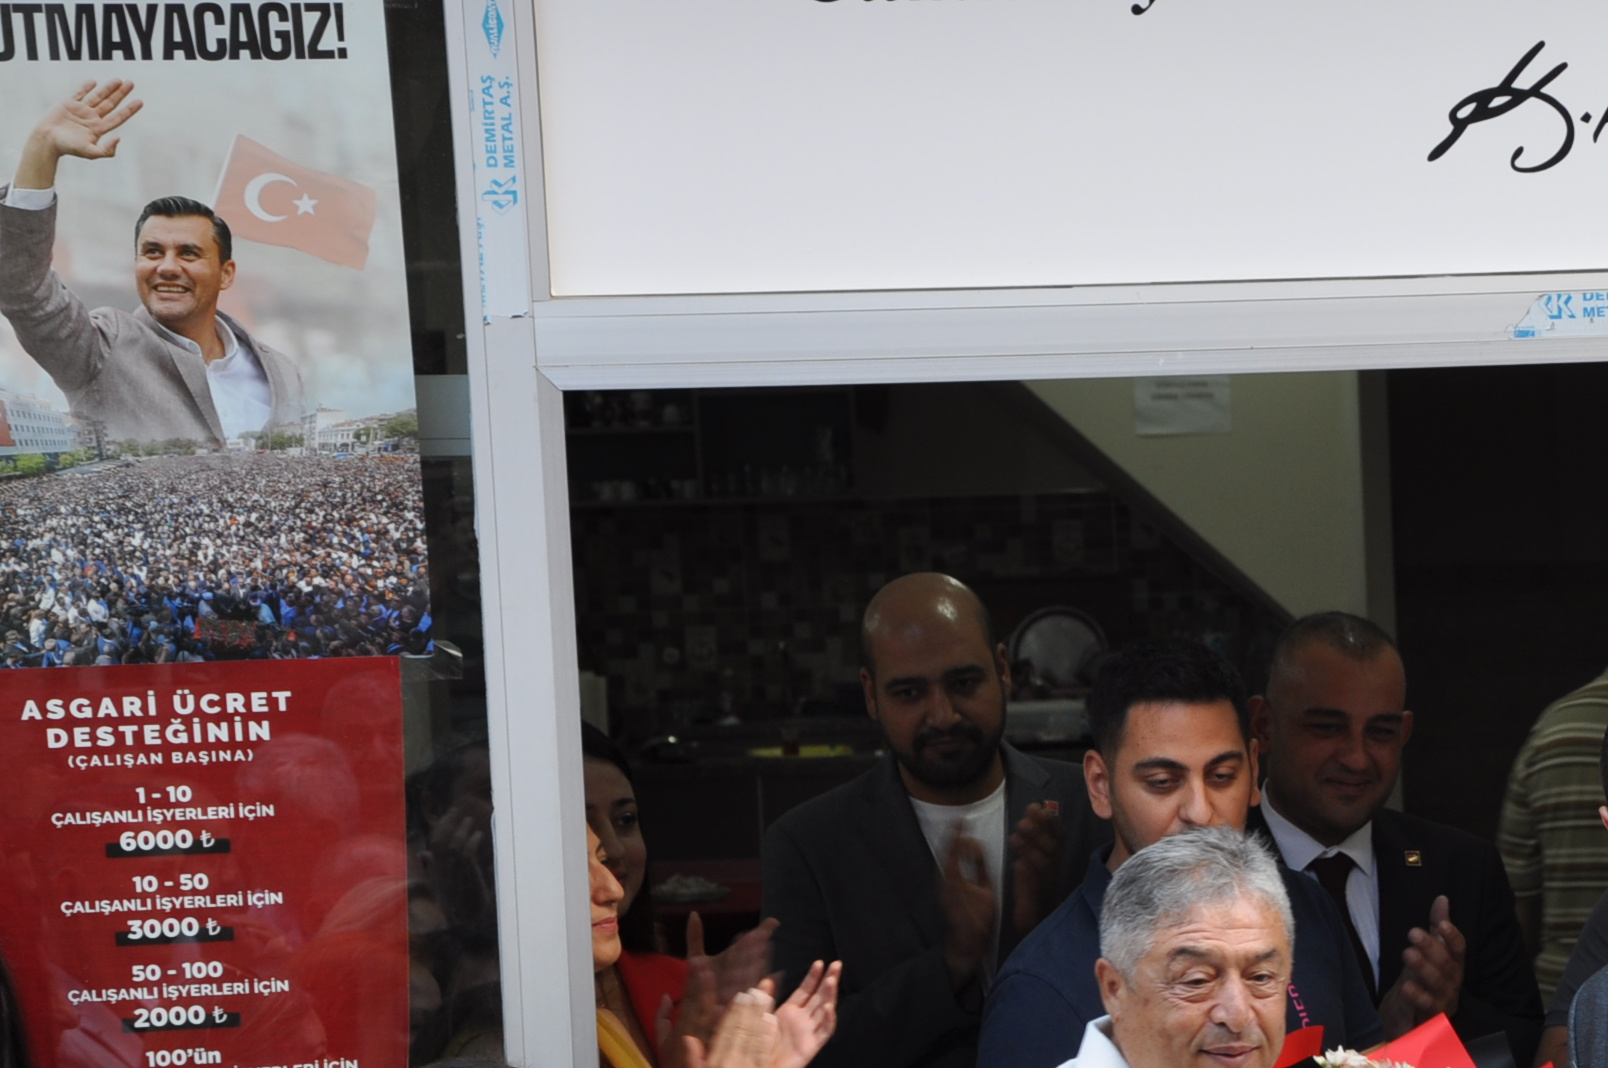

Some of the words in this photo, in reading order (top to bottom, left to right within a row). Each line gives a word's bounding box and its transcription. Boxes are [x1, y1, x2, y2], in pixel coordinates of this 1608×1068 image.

[498, 76, 513, 109] A.Ş.
[481, 75, 498, 168] DEMİRTAŞ
[501, 113, 516, 168] METAL
[21, 690, 156, 721] ASGARİ
[173, 689, 291, 715] ÜCRET
[46, 716, 271, 748] DESTEĞİNİN
[68, 752, 163, 770] (ÇALIŞAN
[171, 749, 254, 766] BAŞINA)
[136, 787, 146, 803] 1
[166, 785, 192, 802] 10
[51, 810, 143, 828] ÇALIŞANLI
[147, 803, 235, 824] İŞYERLERİ
[239, 802, 275, 819] İÇİN
[119, 829, 193, 851] 6000
[132, 875, 158, 892] 10
[179, 873, 209, 891] 50
[60, 899, 151, 917] ÇALIŞANLI
[156, 891, 243, 913] İŞYERLERİ
[247, 890, 283, 908] İÇİN
[127, 917, 199, 939] 3000
[131, 965, 161, 981] 50
[182, 961, 223, 979] 100
[68, 987, 158, 1005] ÇALIŞANLI
[163, 979, 250, 999] İŞYERLERİ
[254, 978, 289, 994] İÇİN
[133, 1005, 206, 1028] 2000
